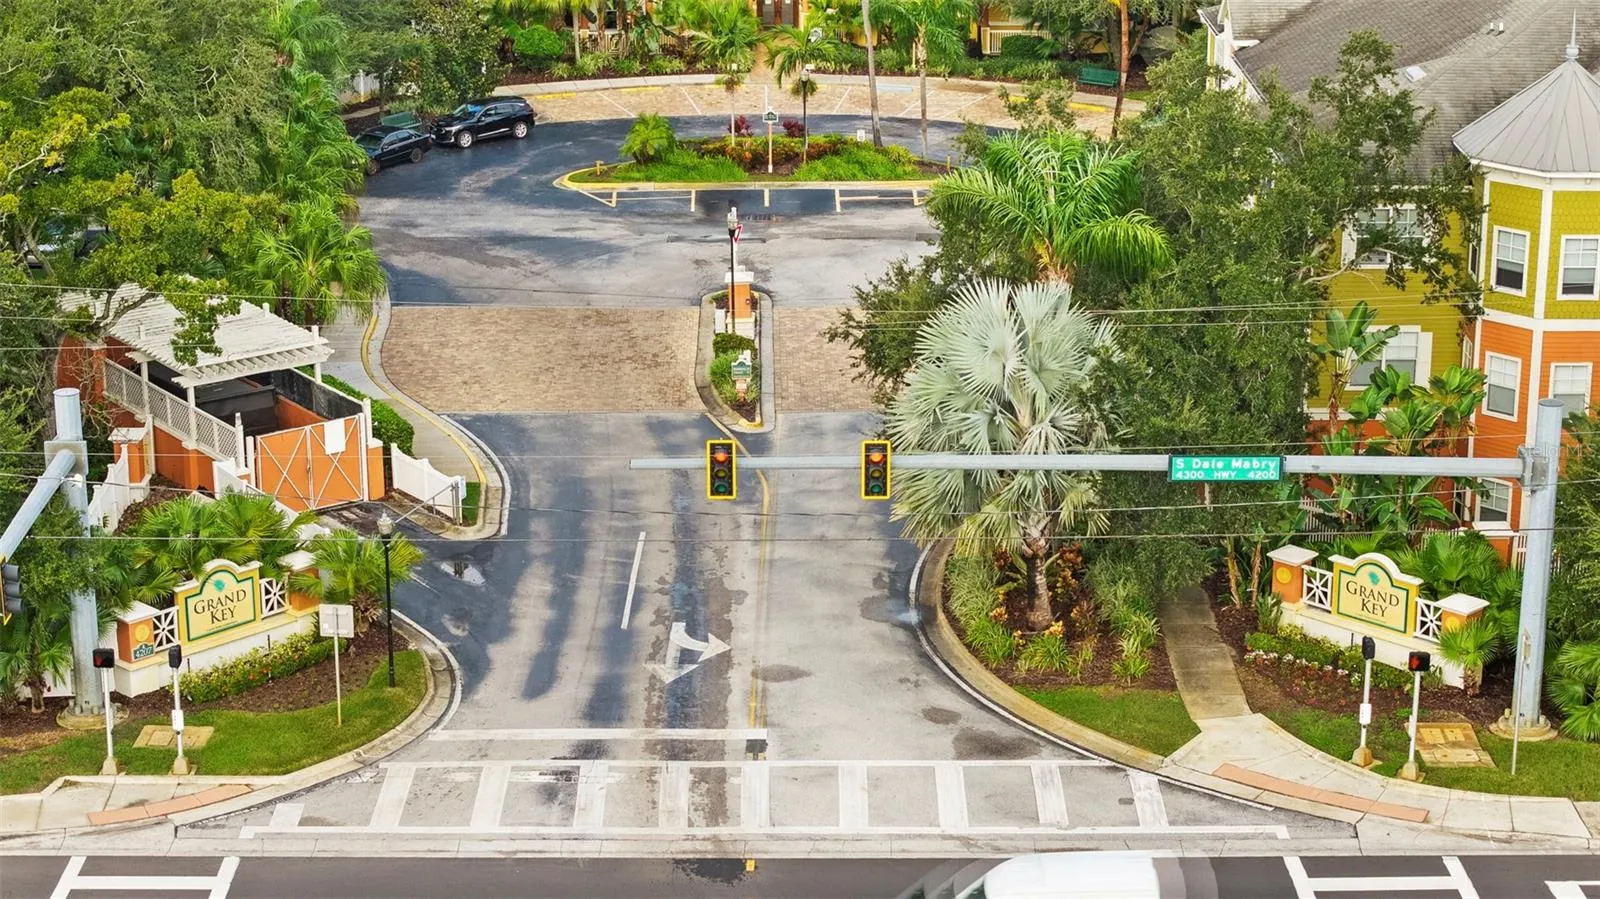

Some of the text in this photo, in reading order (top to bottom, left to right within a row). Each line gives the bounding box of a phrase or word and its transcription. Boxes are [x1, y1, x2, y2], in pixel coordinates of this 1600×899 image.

[1176, 458, 1277, 472] S Dale Mabry
[1176, 471, 1276, 479] 4300 HWY 4200
[194, 589, 247, 615] GRAND
[1346, 580, 1400, 607] GRAND
[210, 606, 237, 625] KEY
[1361, 598, 1388, 617] KEY
